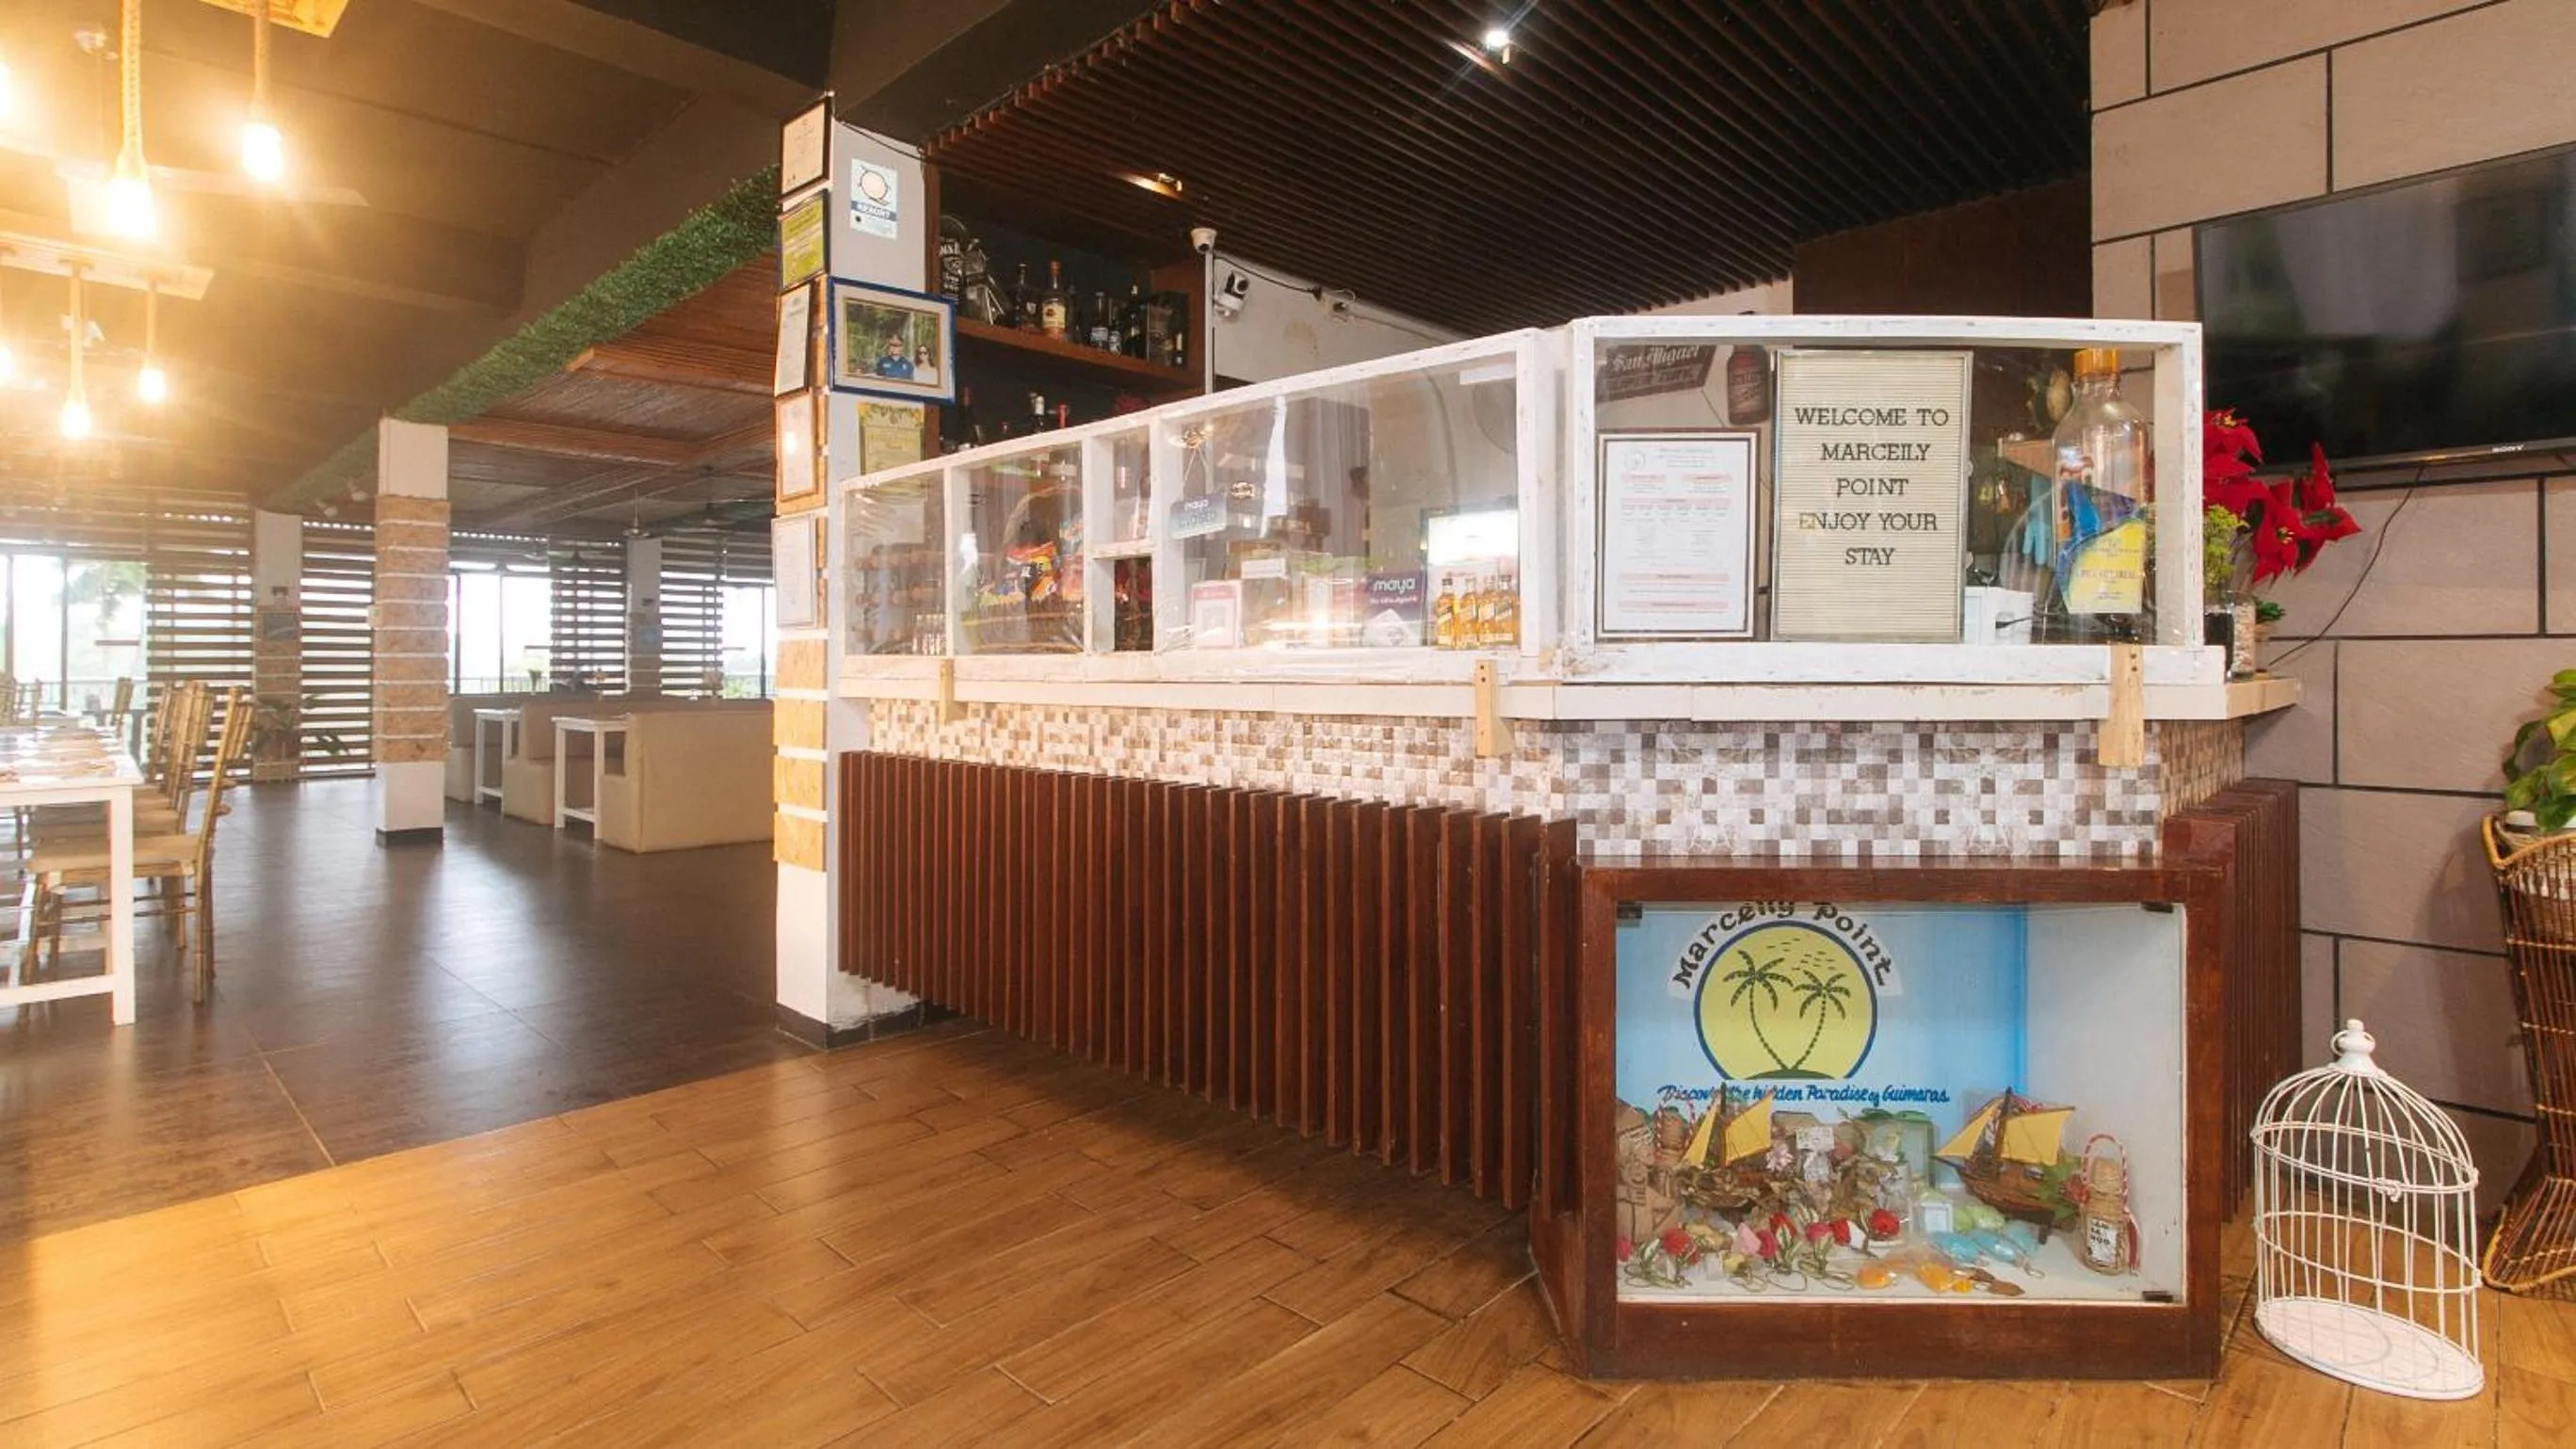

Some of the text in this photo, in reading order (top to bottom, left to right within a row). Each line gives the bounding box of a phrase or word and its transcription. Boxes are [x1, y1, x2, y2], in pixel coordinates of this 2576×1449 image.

[1795, 407, 1950, 427] WELCOME TO
[1820, 443, 1931, 461] MARCEILY
[1837, 477, 1909, 498] POINT
[1798, 512, 1938, 531] ENJOY YOUR
[1844, 547, 1896, 565] STAY
[1373, 578, 1416, 595] maya
[1812, 901, 1892, 987] Point
[1657, 1084, 1721, 1103] Discov
[1806, 1085, 1868, 1102] Paradise
[1882, 1085, 1951, 1103] Guimaras
